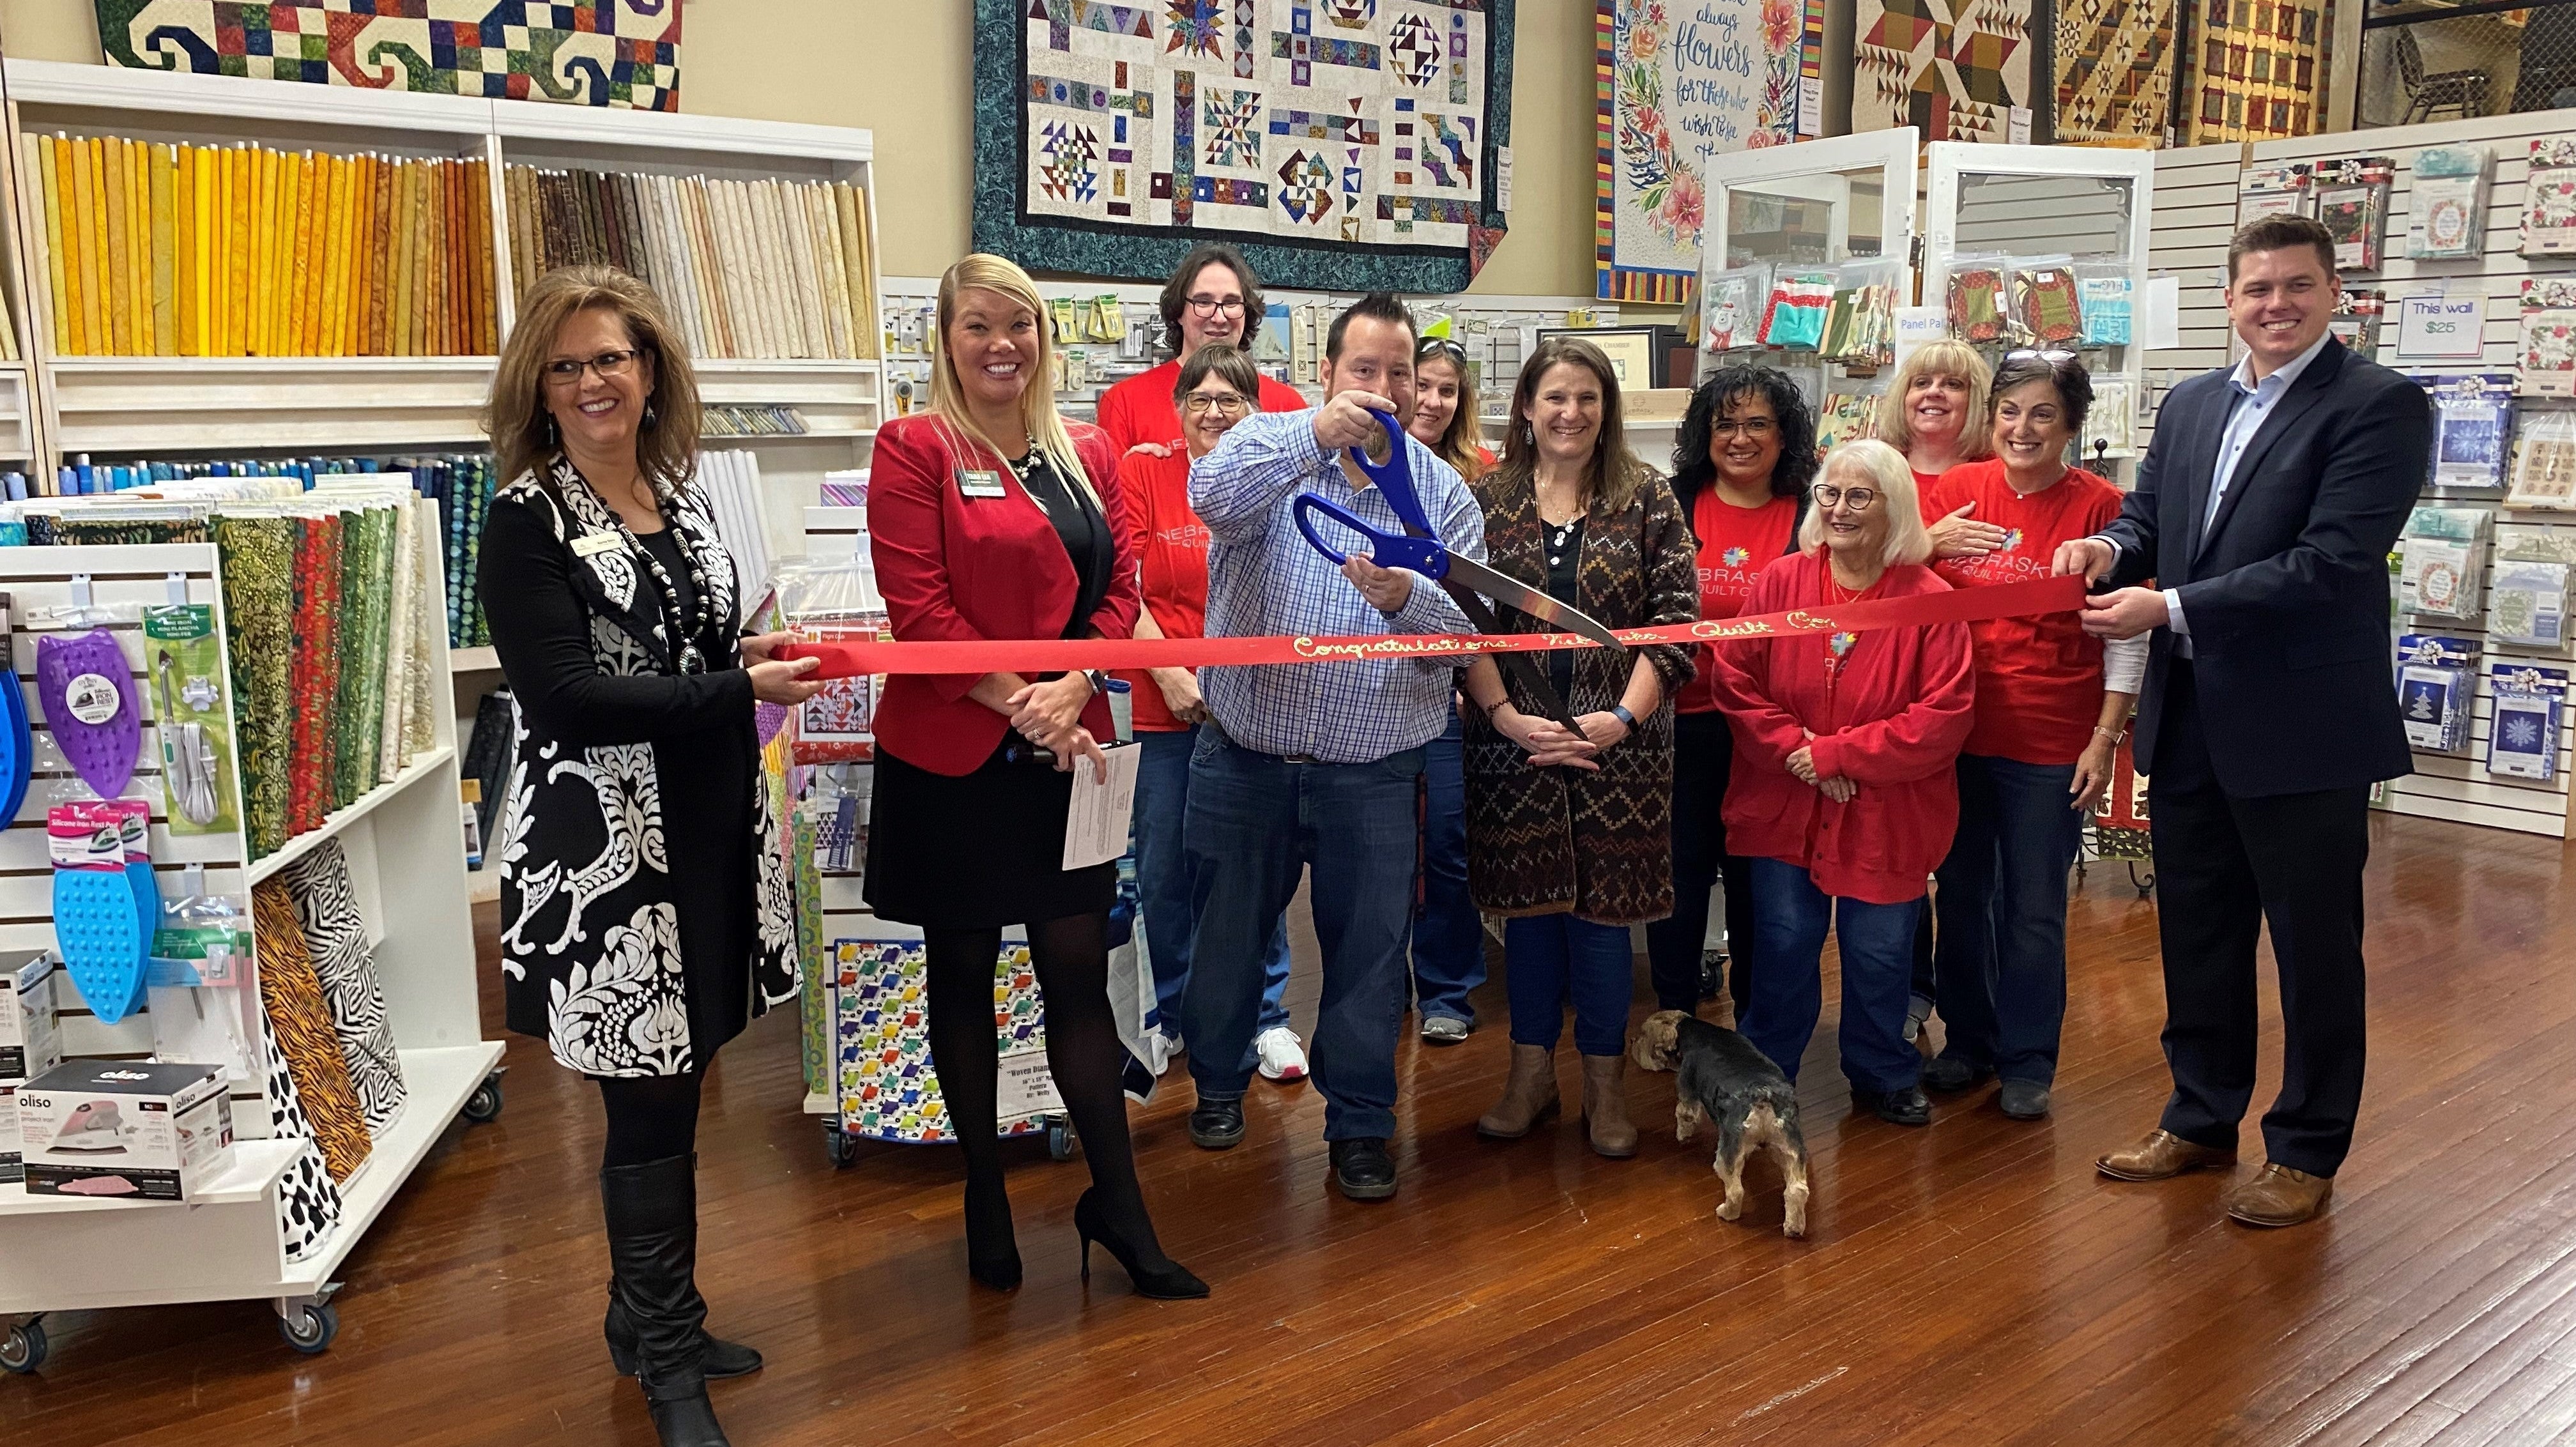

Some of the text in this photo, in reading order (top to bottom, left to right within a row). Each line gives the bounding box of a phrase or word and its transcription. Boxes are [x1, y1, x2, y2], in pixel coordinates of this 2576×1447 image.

[1696, 3, 1740, 42] always
[1669, 20, 1754, 77] flowers
[1671, 76, 1698, 107] for
[1679, 112, 1713, 137] wish
[2413, 302, 2473, 314] This wall
[1901, 319, 1926, 330] Panel
[2425, 321, 2456, 333] $25
[1691, 621, 1774, 638] Quilt
[100, 1069, 150, 1080] oliso
[20, 1094, 51, 1108] oliso
[176, 1094, 195, 1109] oliso
